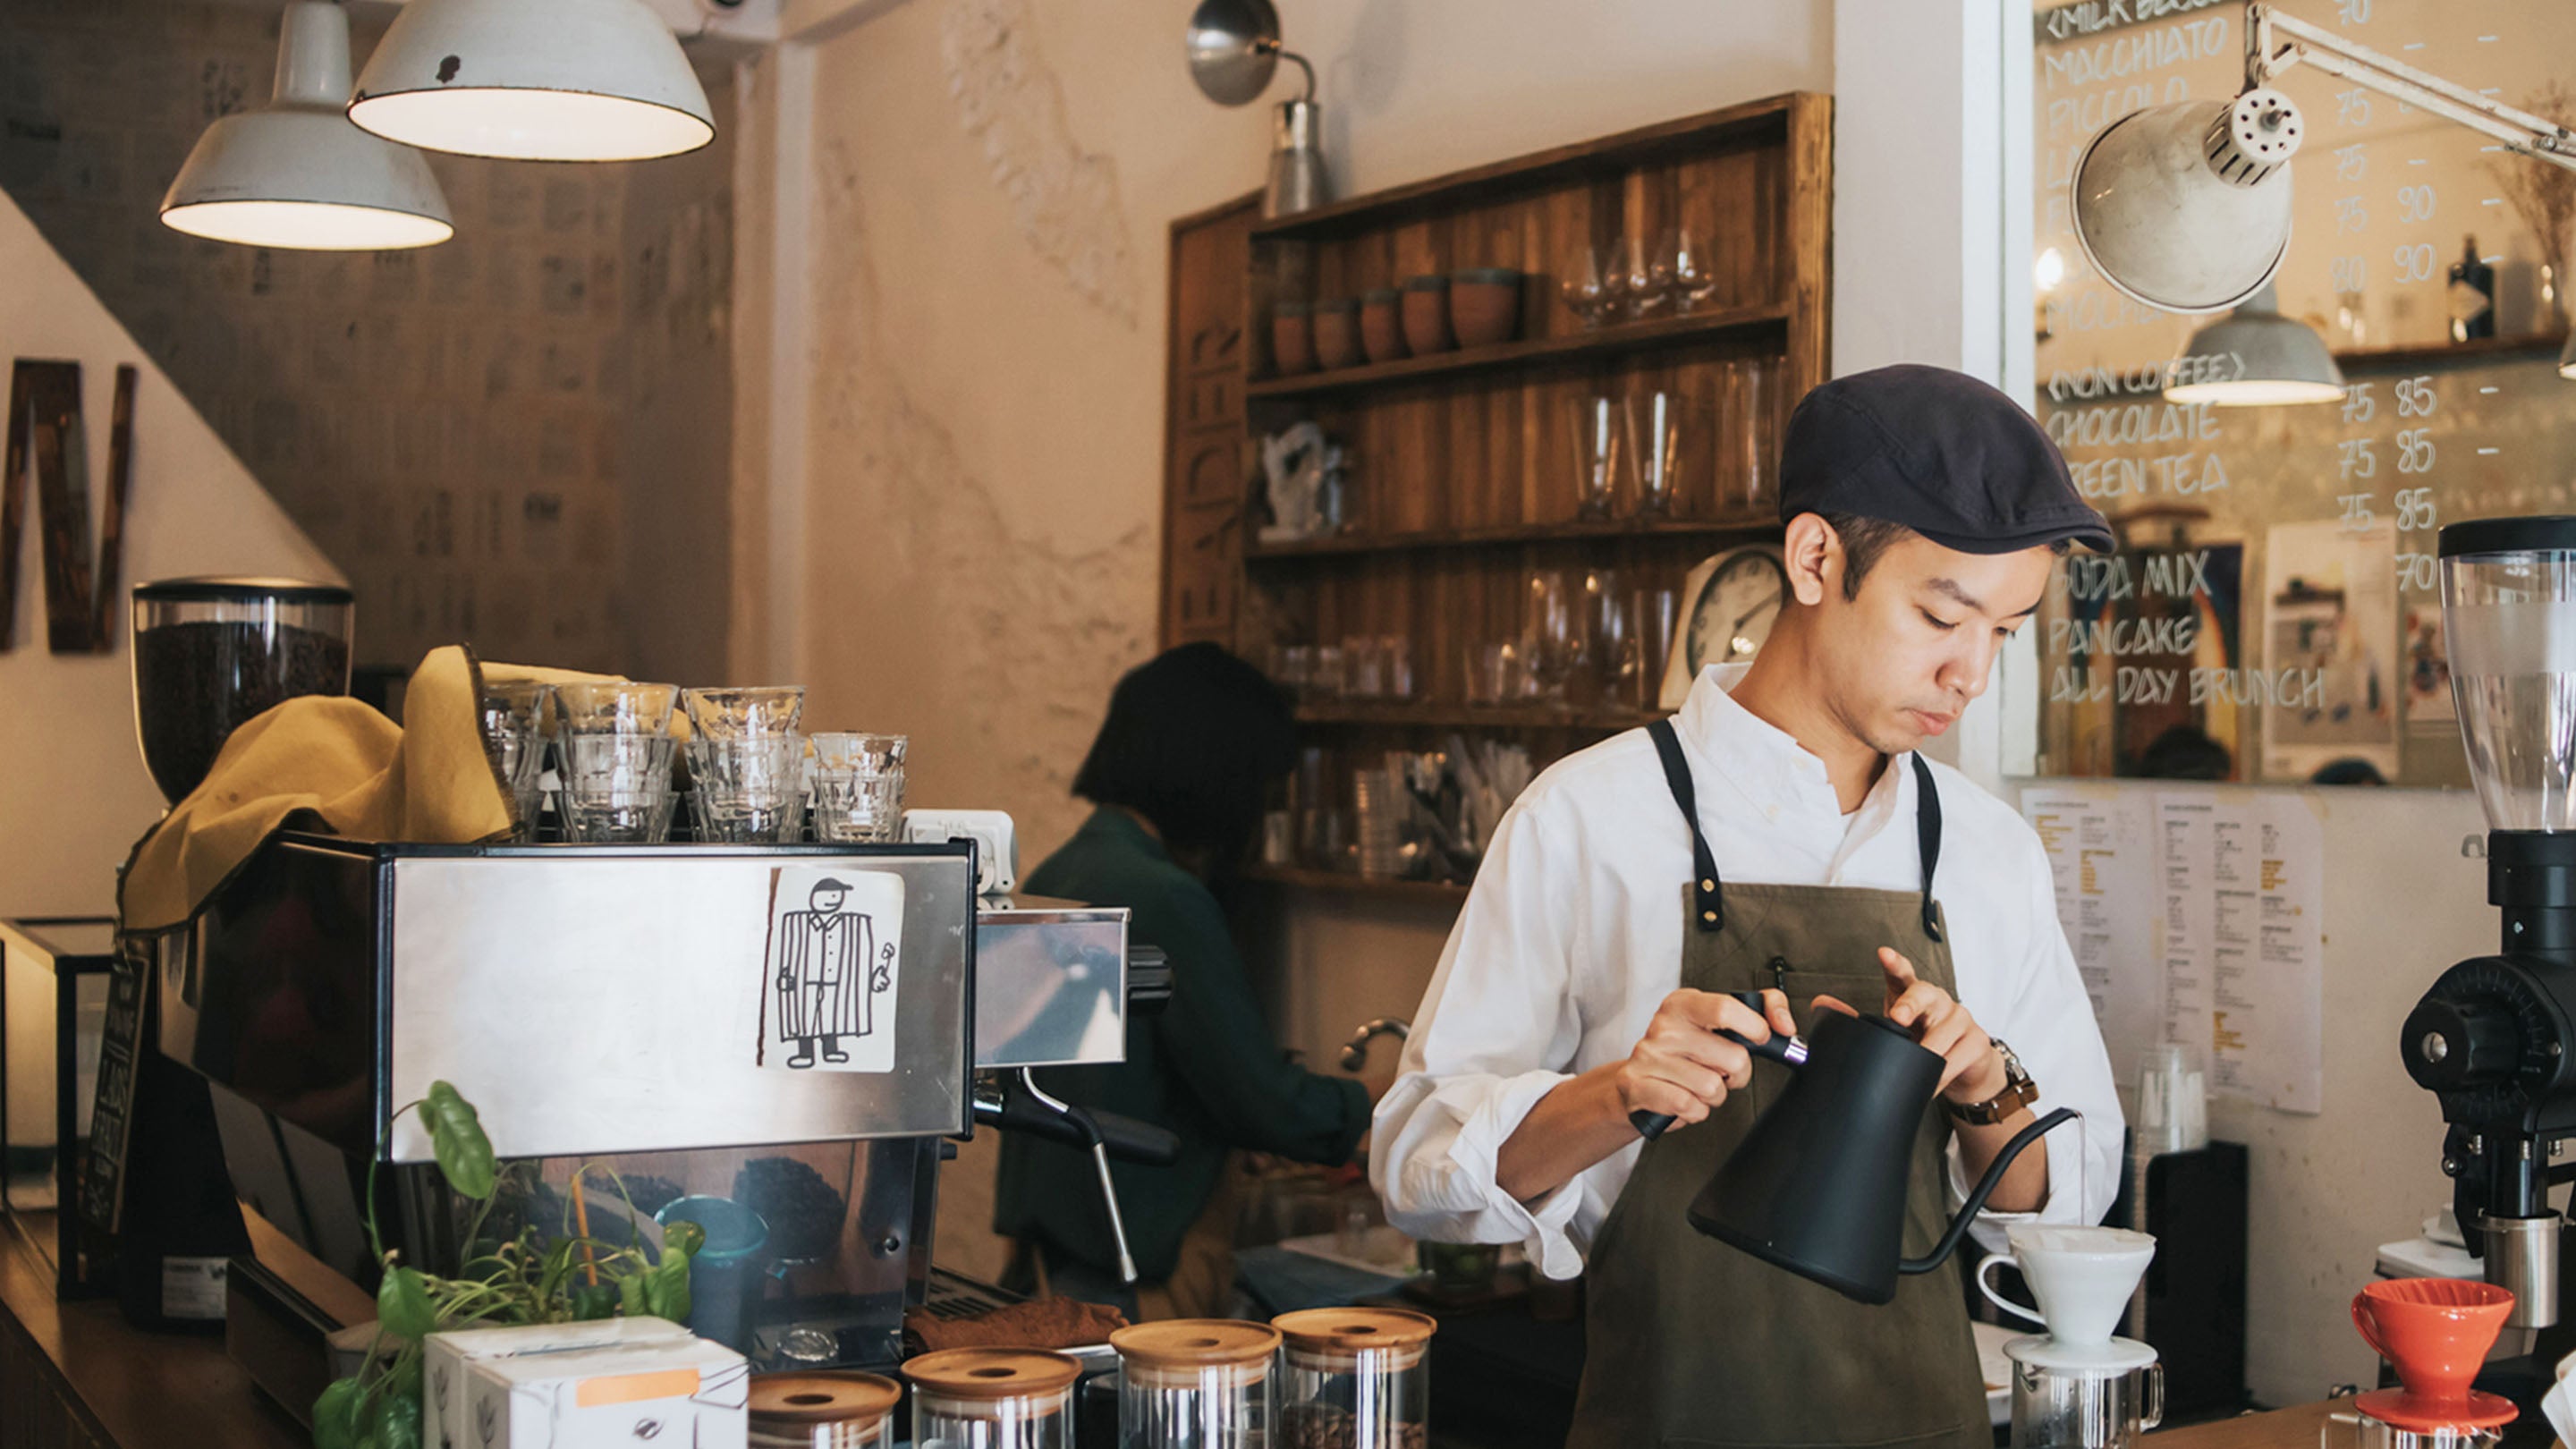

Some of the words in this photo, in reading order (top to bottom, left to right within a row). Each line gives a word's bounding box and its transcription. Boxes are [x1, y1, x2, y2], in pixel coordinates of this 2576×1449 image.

[2045, 16, 2228, 89] MACCHIATO
[2335, 88, 2371, 127] 75
[2334, 143, 2368, 182] 75
[2334, 194, 2368, 236] 75
[2398, 184, 2436, 224] 90
[2331, 254, 2367, 294] 80
[2394, 242, 2436, 284] 90
[2046, 400, 2223, 449] CHOCOLATE
[2340, 383, 2377, 424] 75
[2395, 376, 2438, 419] 85
[2068, 457, 2148, 499] REEN
[2153, 452, 2230, 496] TEA
[2337, 437, 2377, 480] 75
[2396, 427, 2437, 474] 85
[2336, 493, 2377, 533] 75
[2394, 486, 2437, 532] 85
[2141, 549, 2213, 598] MIX
[2394, 552, 2439, 592] 70
[2049, 614, 2199, 657] PANCAKE
[2050, 665, 2111, 705] ALL
[2117, 665, 2180, 706] DAY
[2188, 665, 2327, 710] BRUNCH
